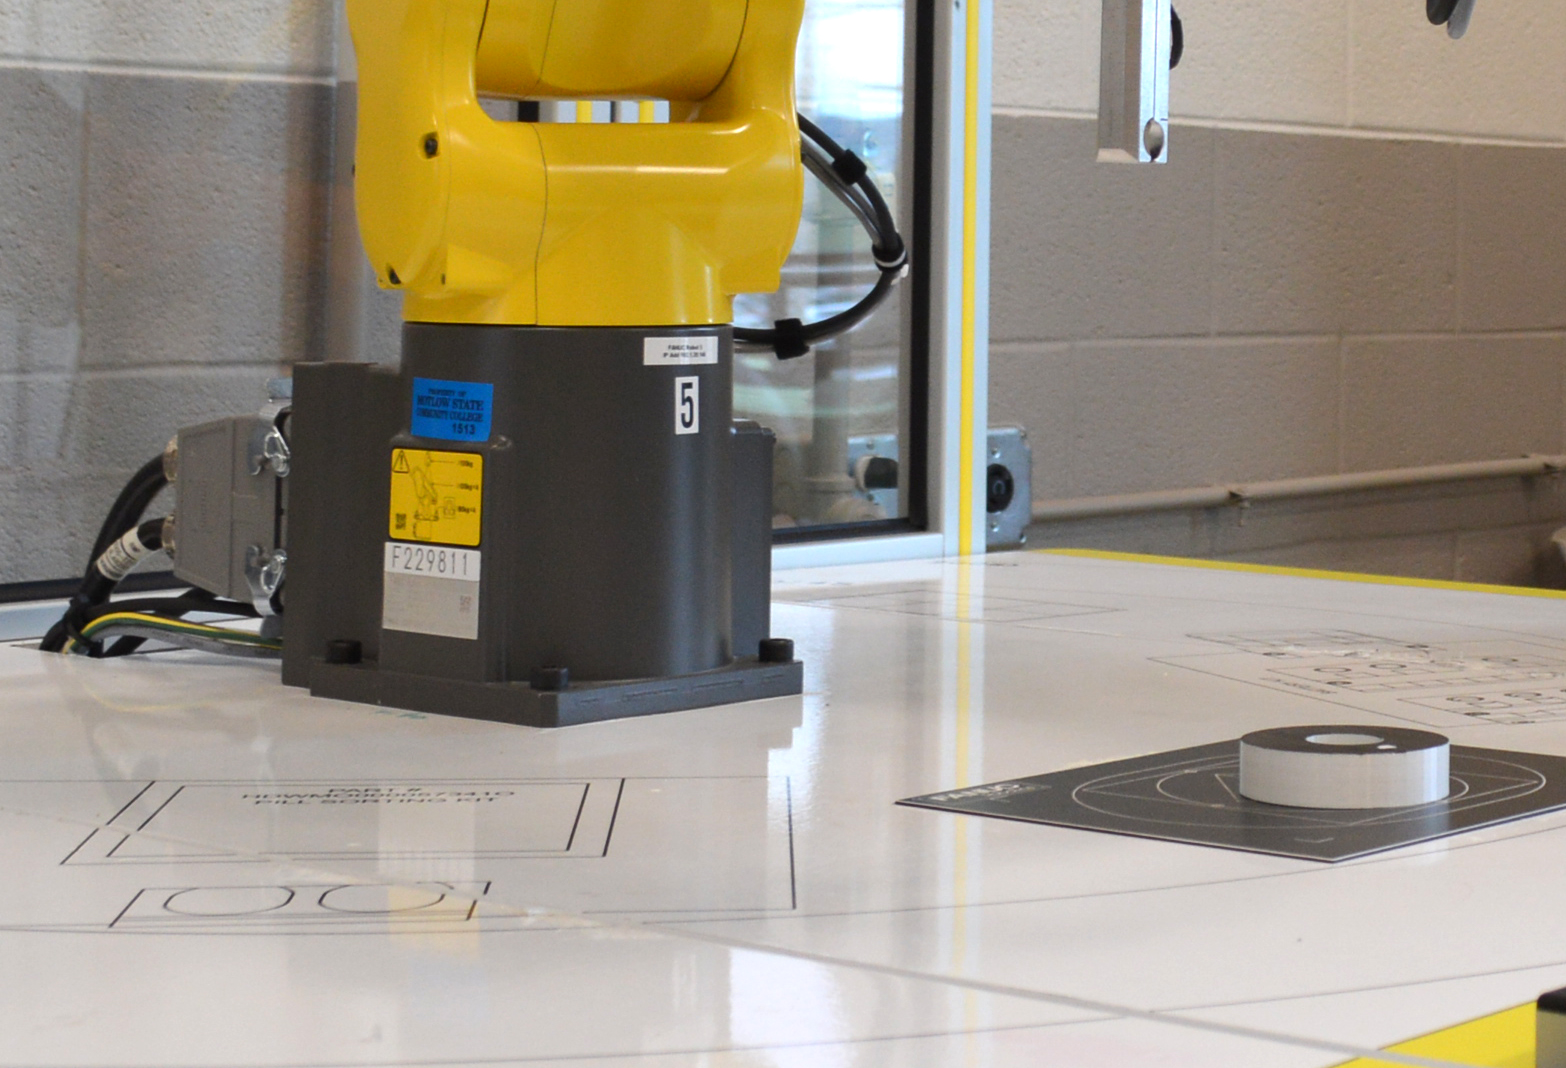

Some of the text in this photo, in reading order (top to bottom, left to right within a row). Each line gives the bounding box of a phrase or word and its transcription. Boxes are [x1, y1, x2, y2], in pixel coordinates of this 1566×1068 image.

[417, 395, 484, 411] MOTLOW STATE
[681, 382, 694, 428] 5
[450, 410, 483, 423] COLLEGE
[452, 423, 476, 435] 1513
[391, 544, 469, 576] F229811
